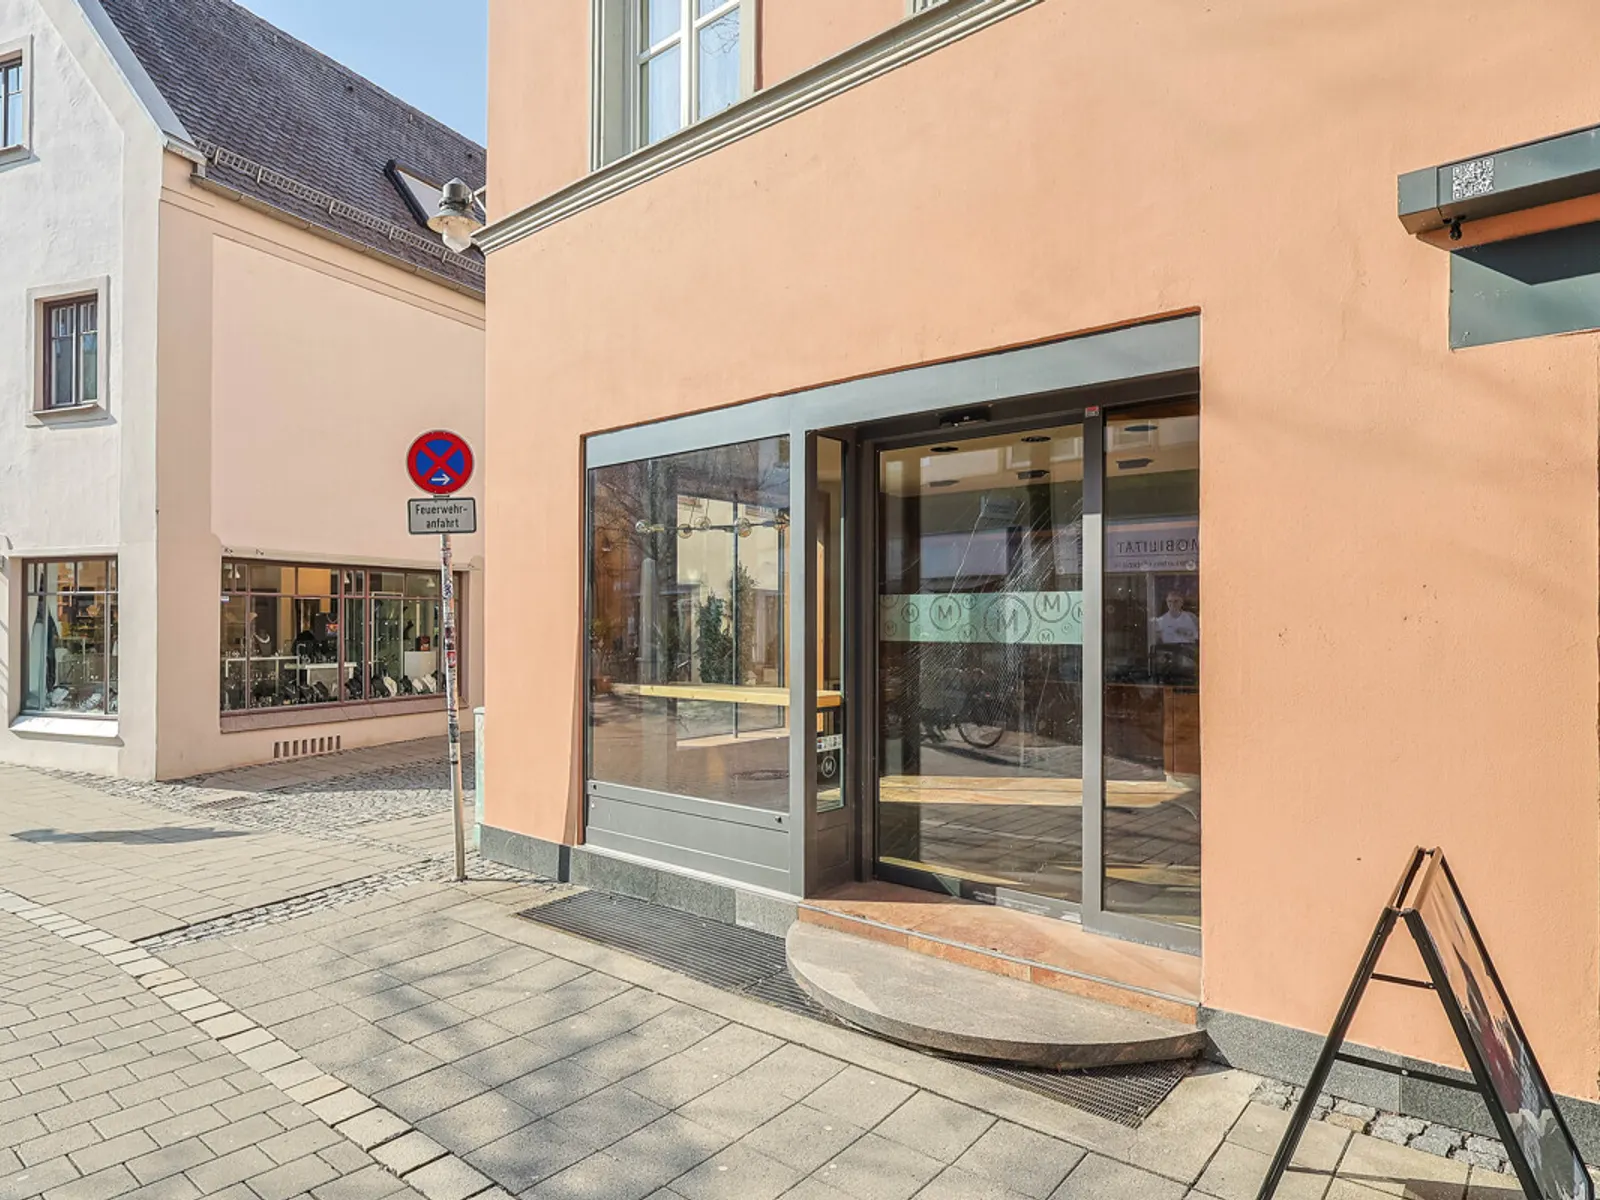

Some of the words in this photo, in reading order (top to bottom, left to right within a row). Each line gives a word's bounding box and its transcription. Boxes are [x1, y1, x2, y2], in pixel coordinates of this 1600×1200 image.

[415, 504, 468, 515] Feuerwehr-
[426, 518, 460, 529] anfahrt
[1043, 594, 1061, 613] M
[938, 604, 953, 622] M
[996, 608, 1019, 635] M
